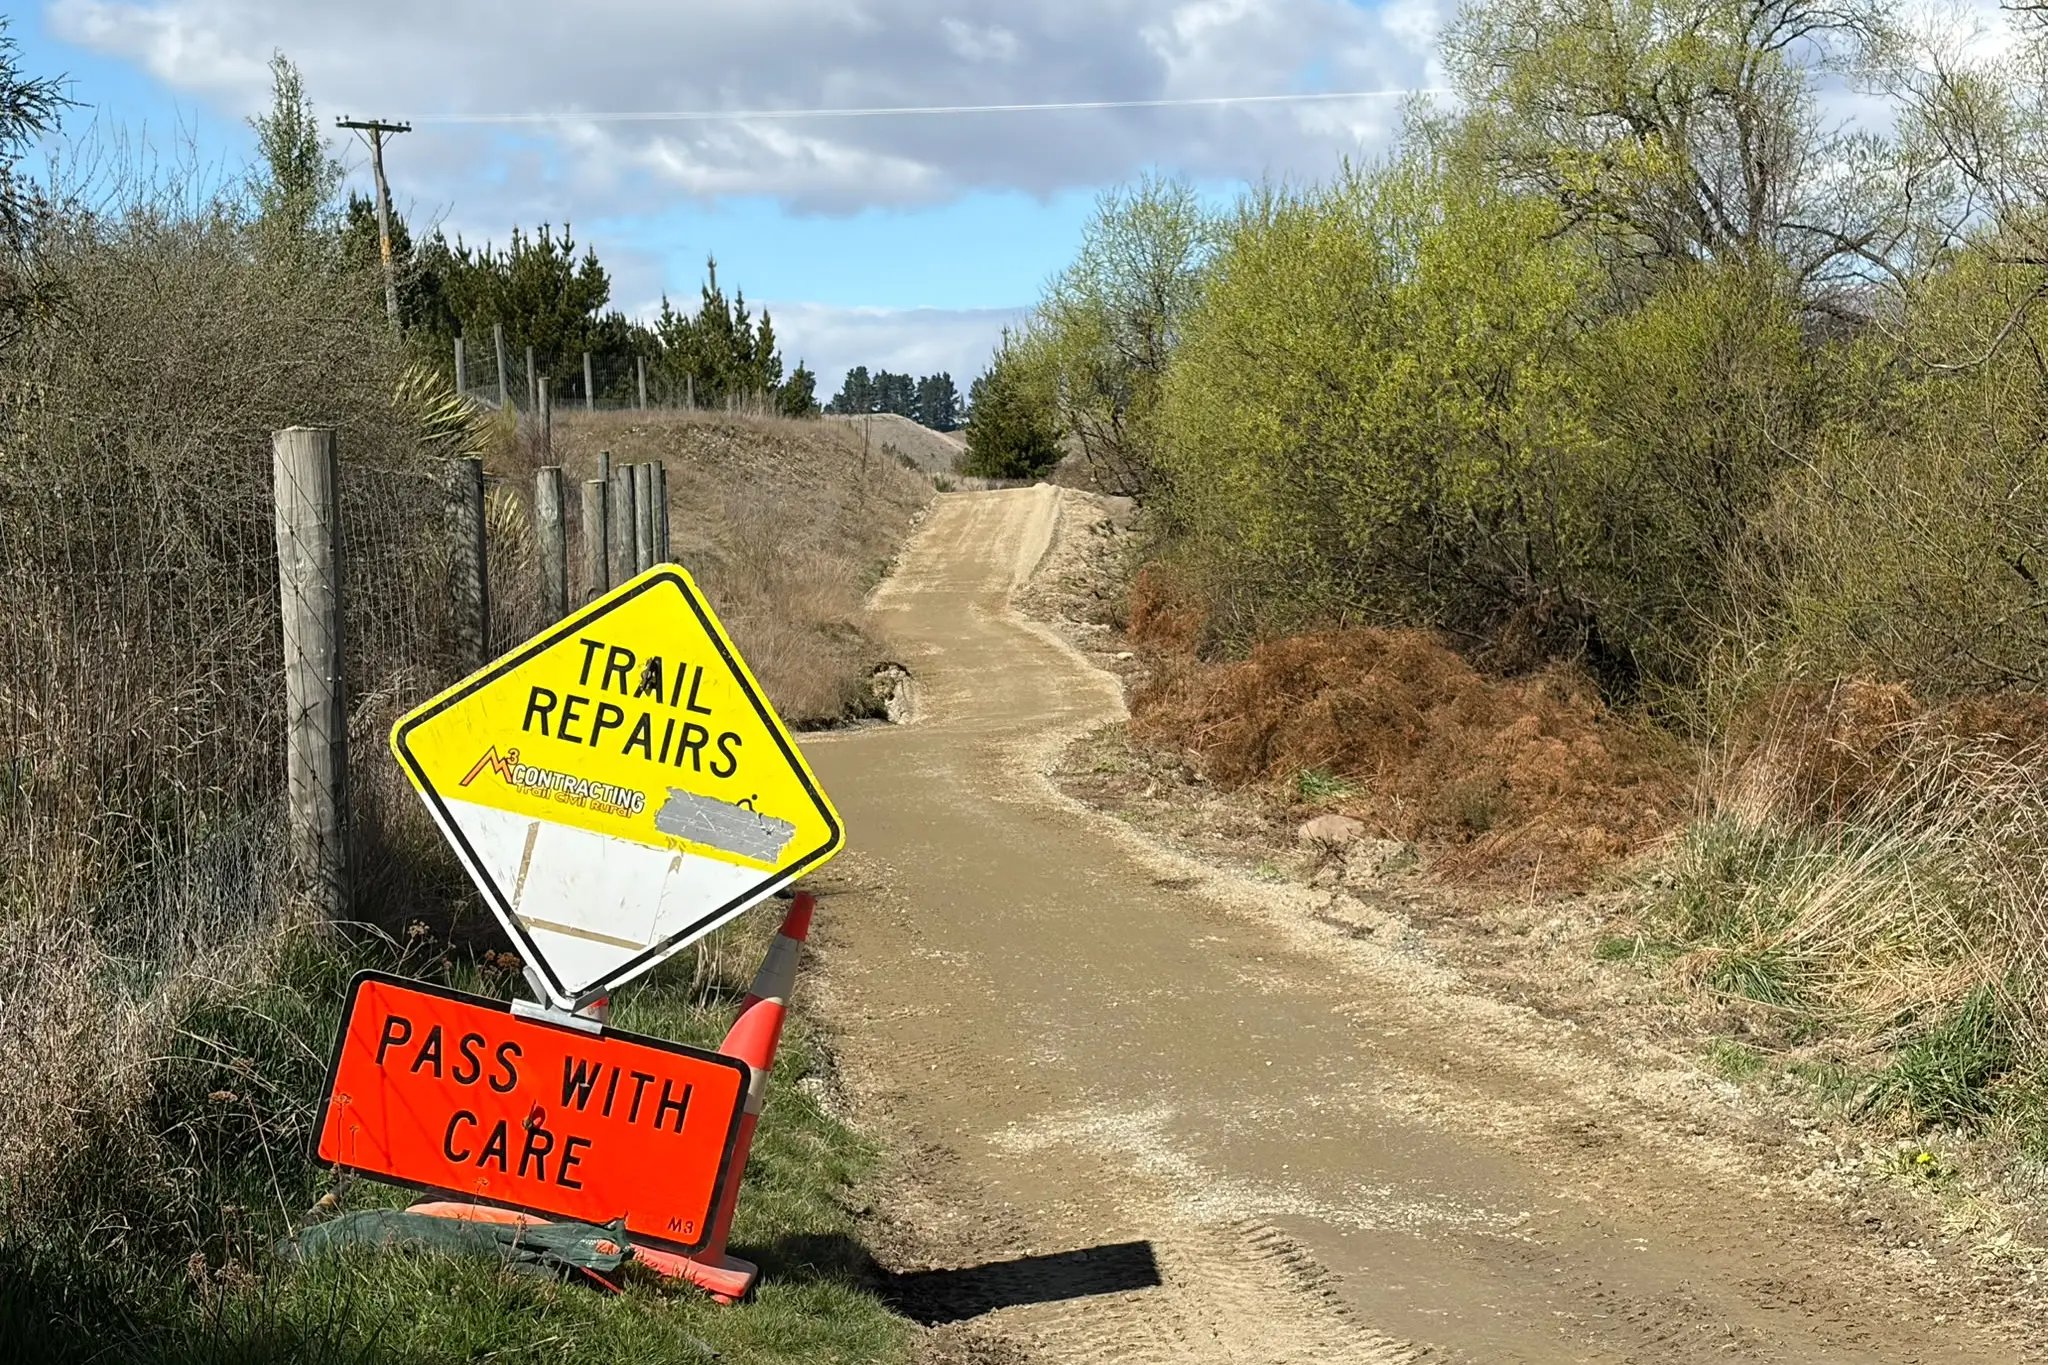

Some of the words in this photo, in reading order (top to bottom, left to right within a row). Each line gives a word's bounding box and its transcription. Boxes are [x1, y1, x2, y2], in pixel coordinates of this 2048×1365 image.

[578, 638, 713, 715] TRAIL
[522, 686, 742, 779] REPAIRS
[512, 764, 646, 814] CONTRACTING
[516, 782, 550, 799] Trail
[554, 792, 586, 808] Civil
[590, 801, 632, 818] Rural
[376, 1015, 524, 1093] PASS
[560, 1055, 693, 1134] WITH
[443, 1109, 592, 1190] CARE
[667, 1215, 694, 1234] M3
